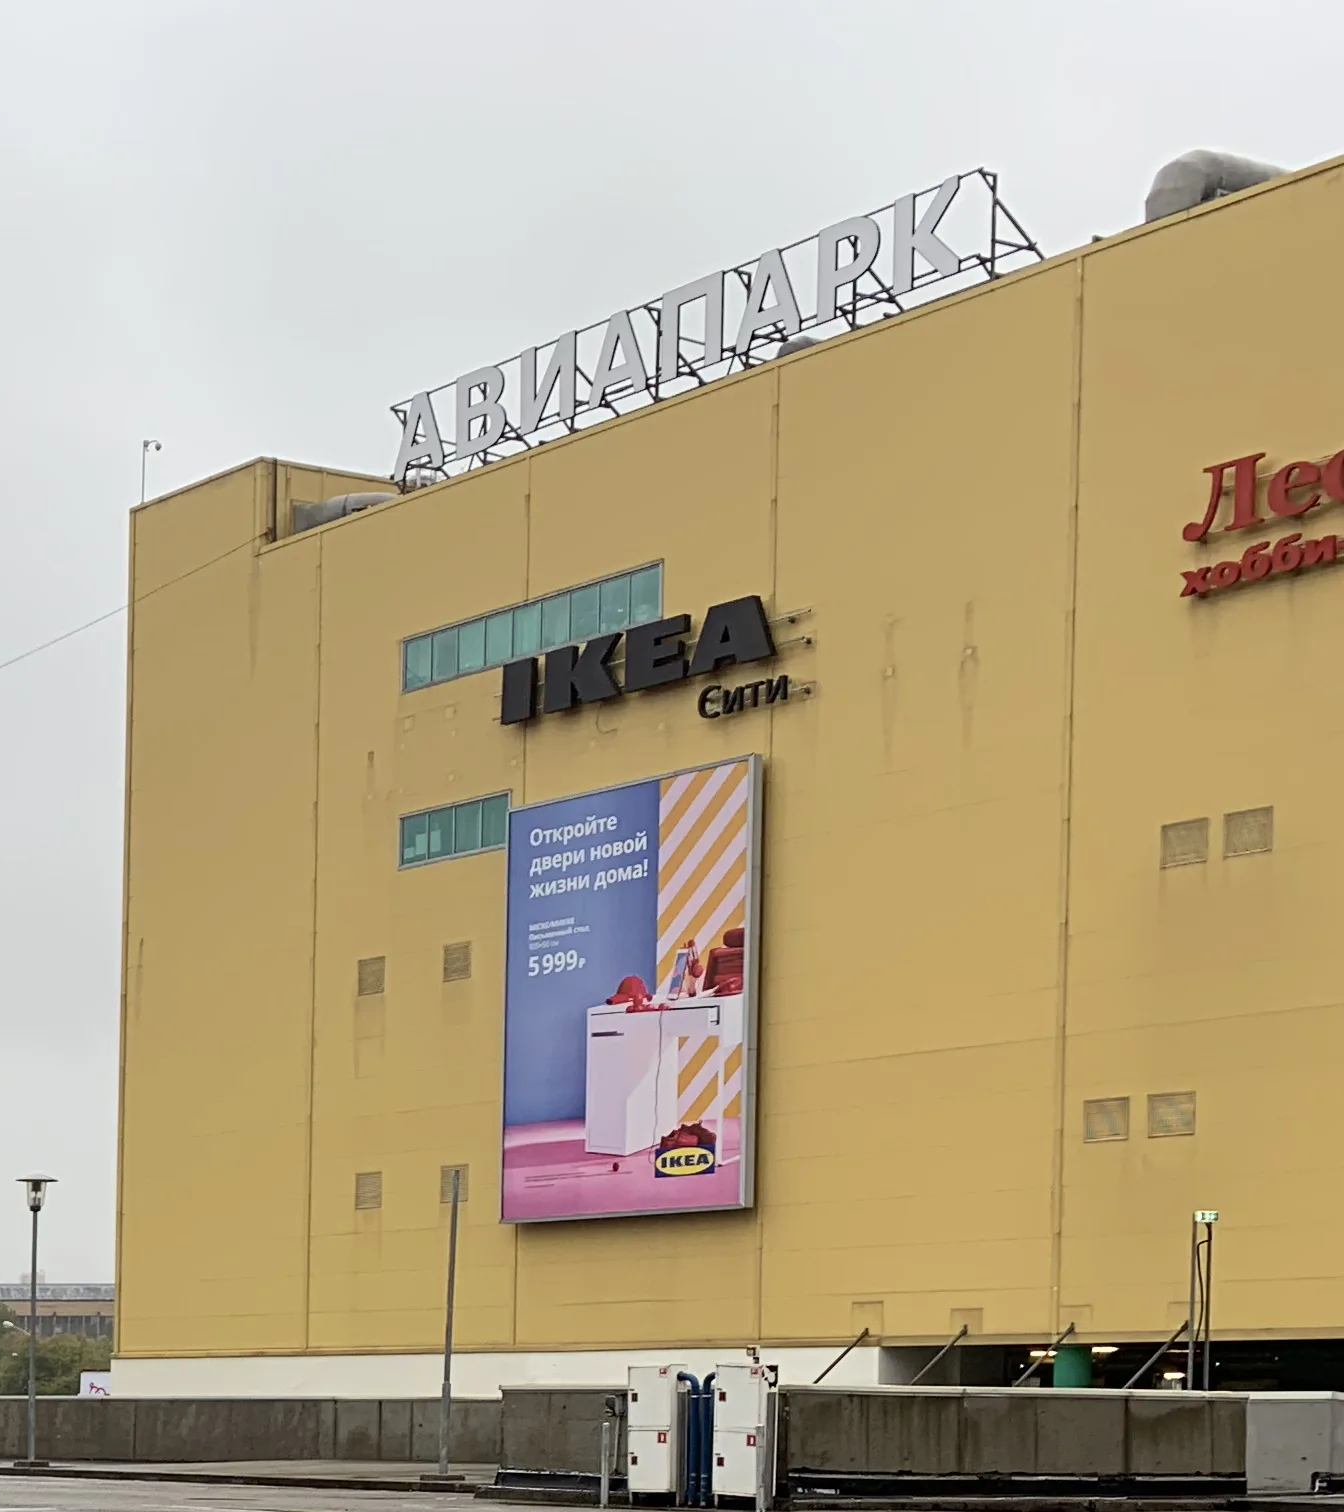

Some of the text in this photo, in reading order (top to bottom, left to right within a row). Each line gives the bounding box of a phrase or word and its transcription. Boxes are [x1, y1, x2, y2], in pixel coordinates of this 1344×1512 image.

[393, 175, 962, 481] АВИАПАРК
[501, 595, 776, 725] IKEA
[698, 675, 788, 719] Сити
[529, 814, 618, 847] Откройте
[528, 830, 648, 877] двери новой
[528, 858, 649, 900] жизни дома!
[661, 1153, 710, 1169] IKEA
